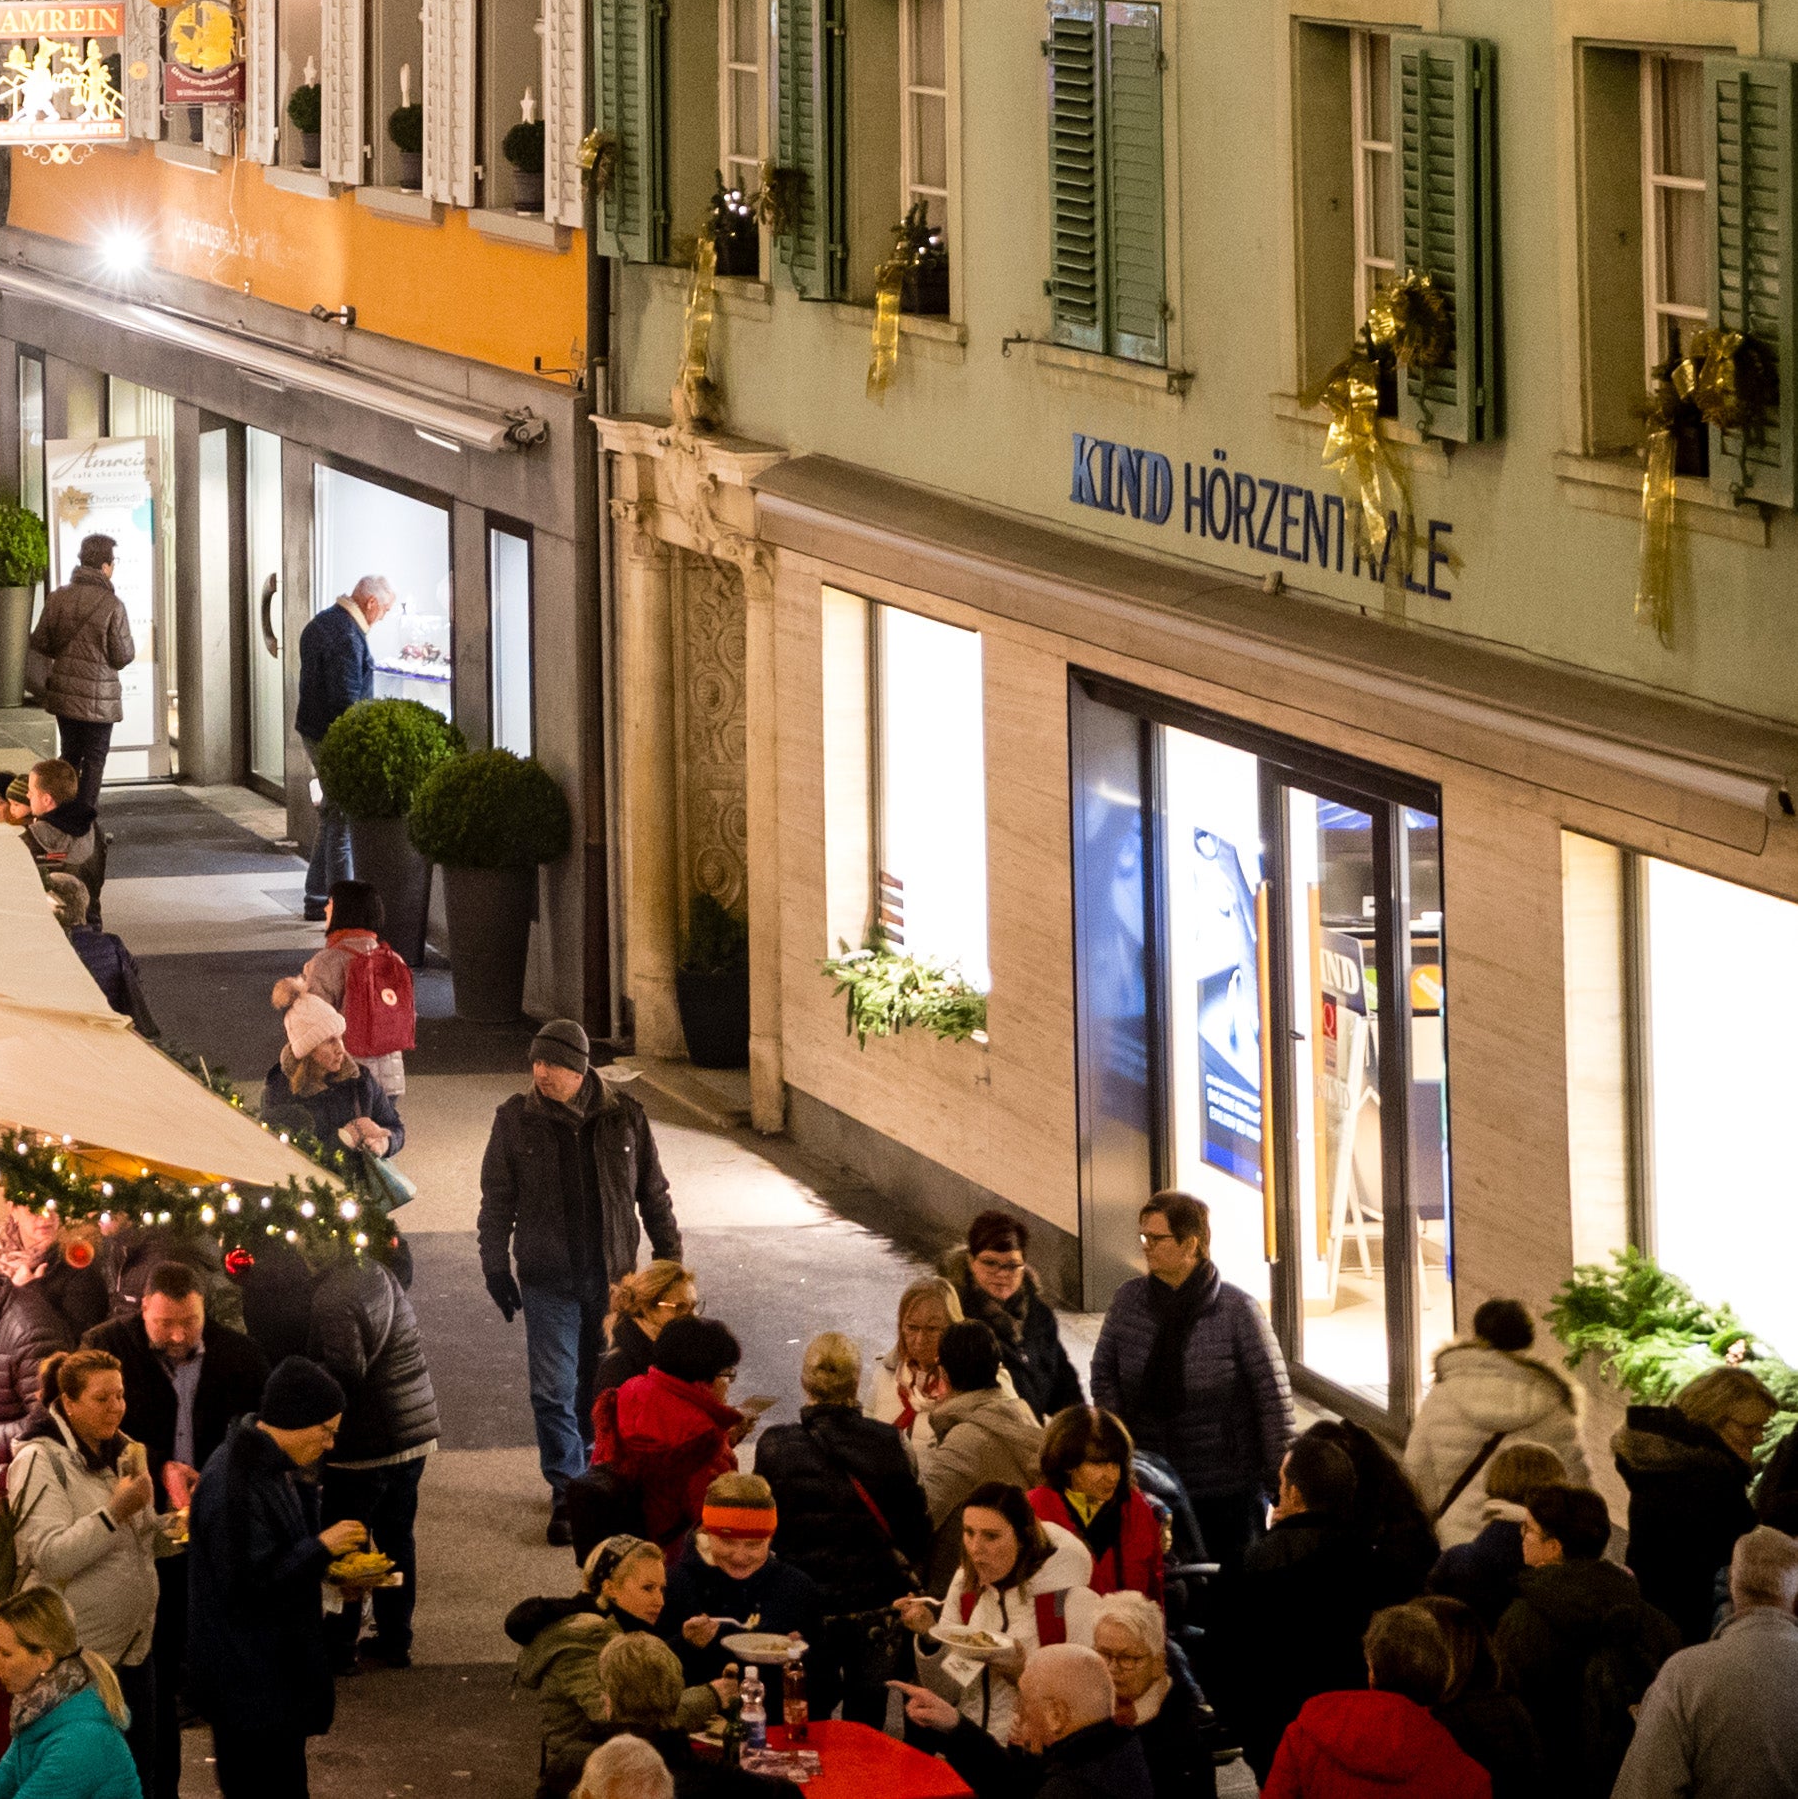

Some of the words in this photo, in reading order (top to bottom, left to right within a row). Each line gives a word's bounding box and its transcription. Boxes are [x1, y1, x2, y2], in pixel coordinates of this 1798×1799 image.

[0, 8, 119, 33] AMREIN
[1069, 432, 1173, 527] KIND
[1320, 947, 1360, 995] IND
